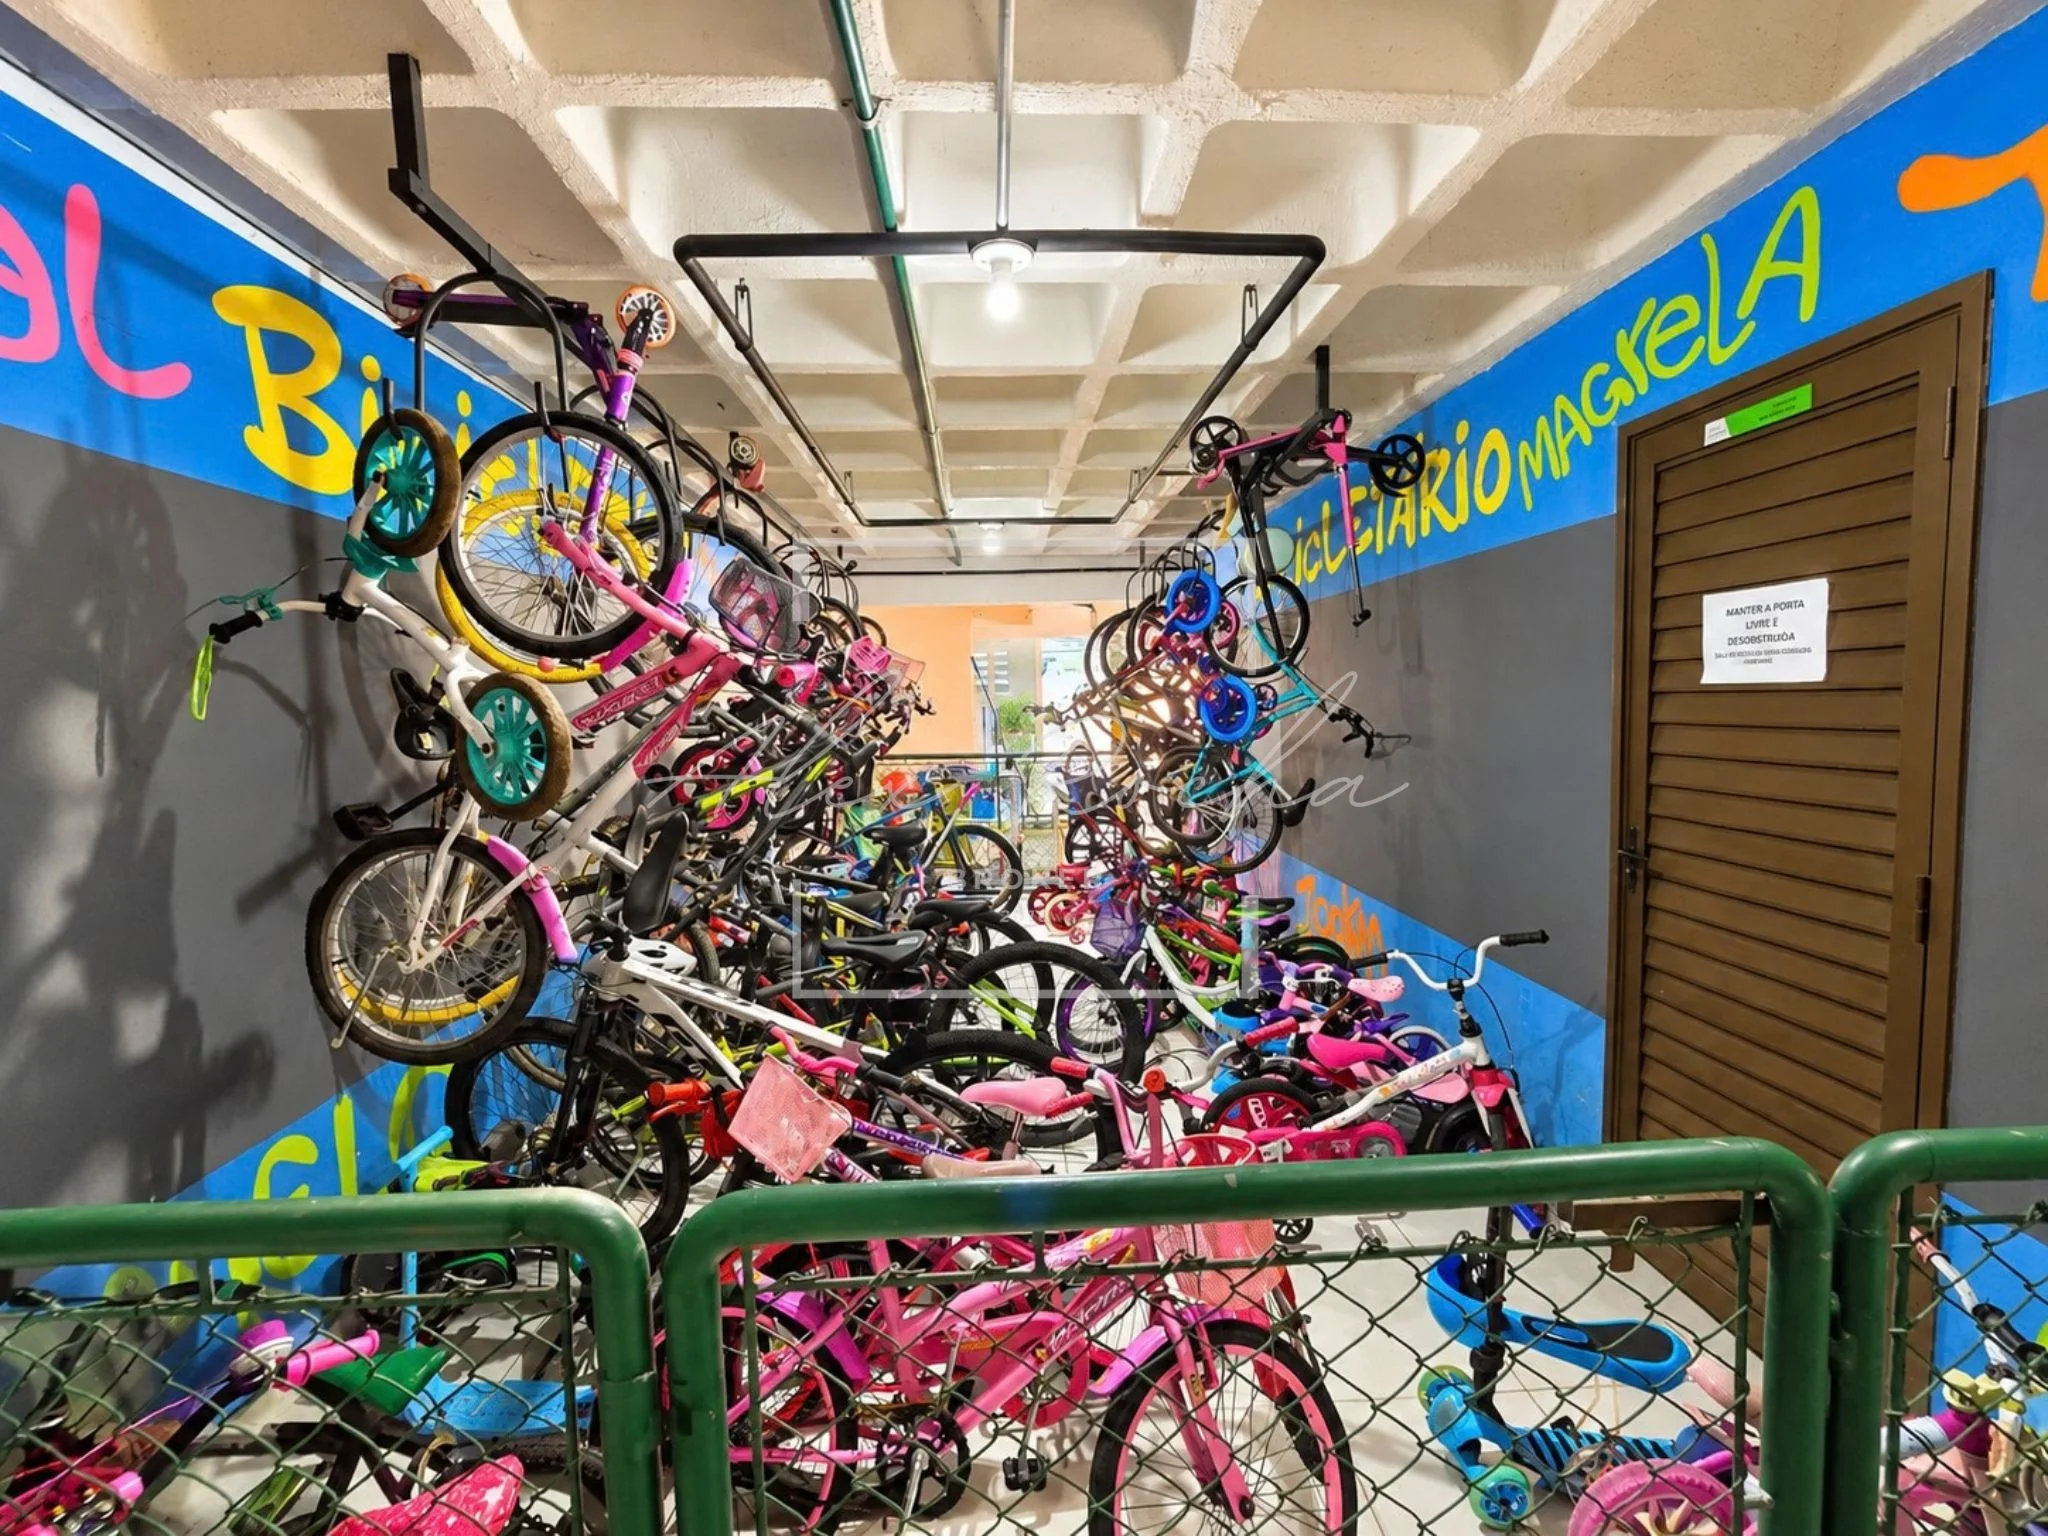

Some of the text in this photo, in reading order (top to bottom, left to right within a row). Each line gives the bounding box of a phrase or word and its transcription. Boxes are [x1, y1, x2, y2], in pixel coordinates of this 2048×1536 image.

[1726, 599, 1805, 617] MANTER A PORTA
[1745, 617, 1779, 630] LIVRE E
